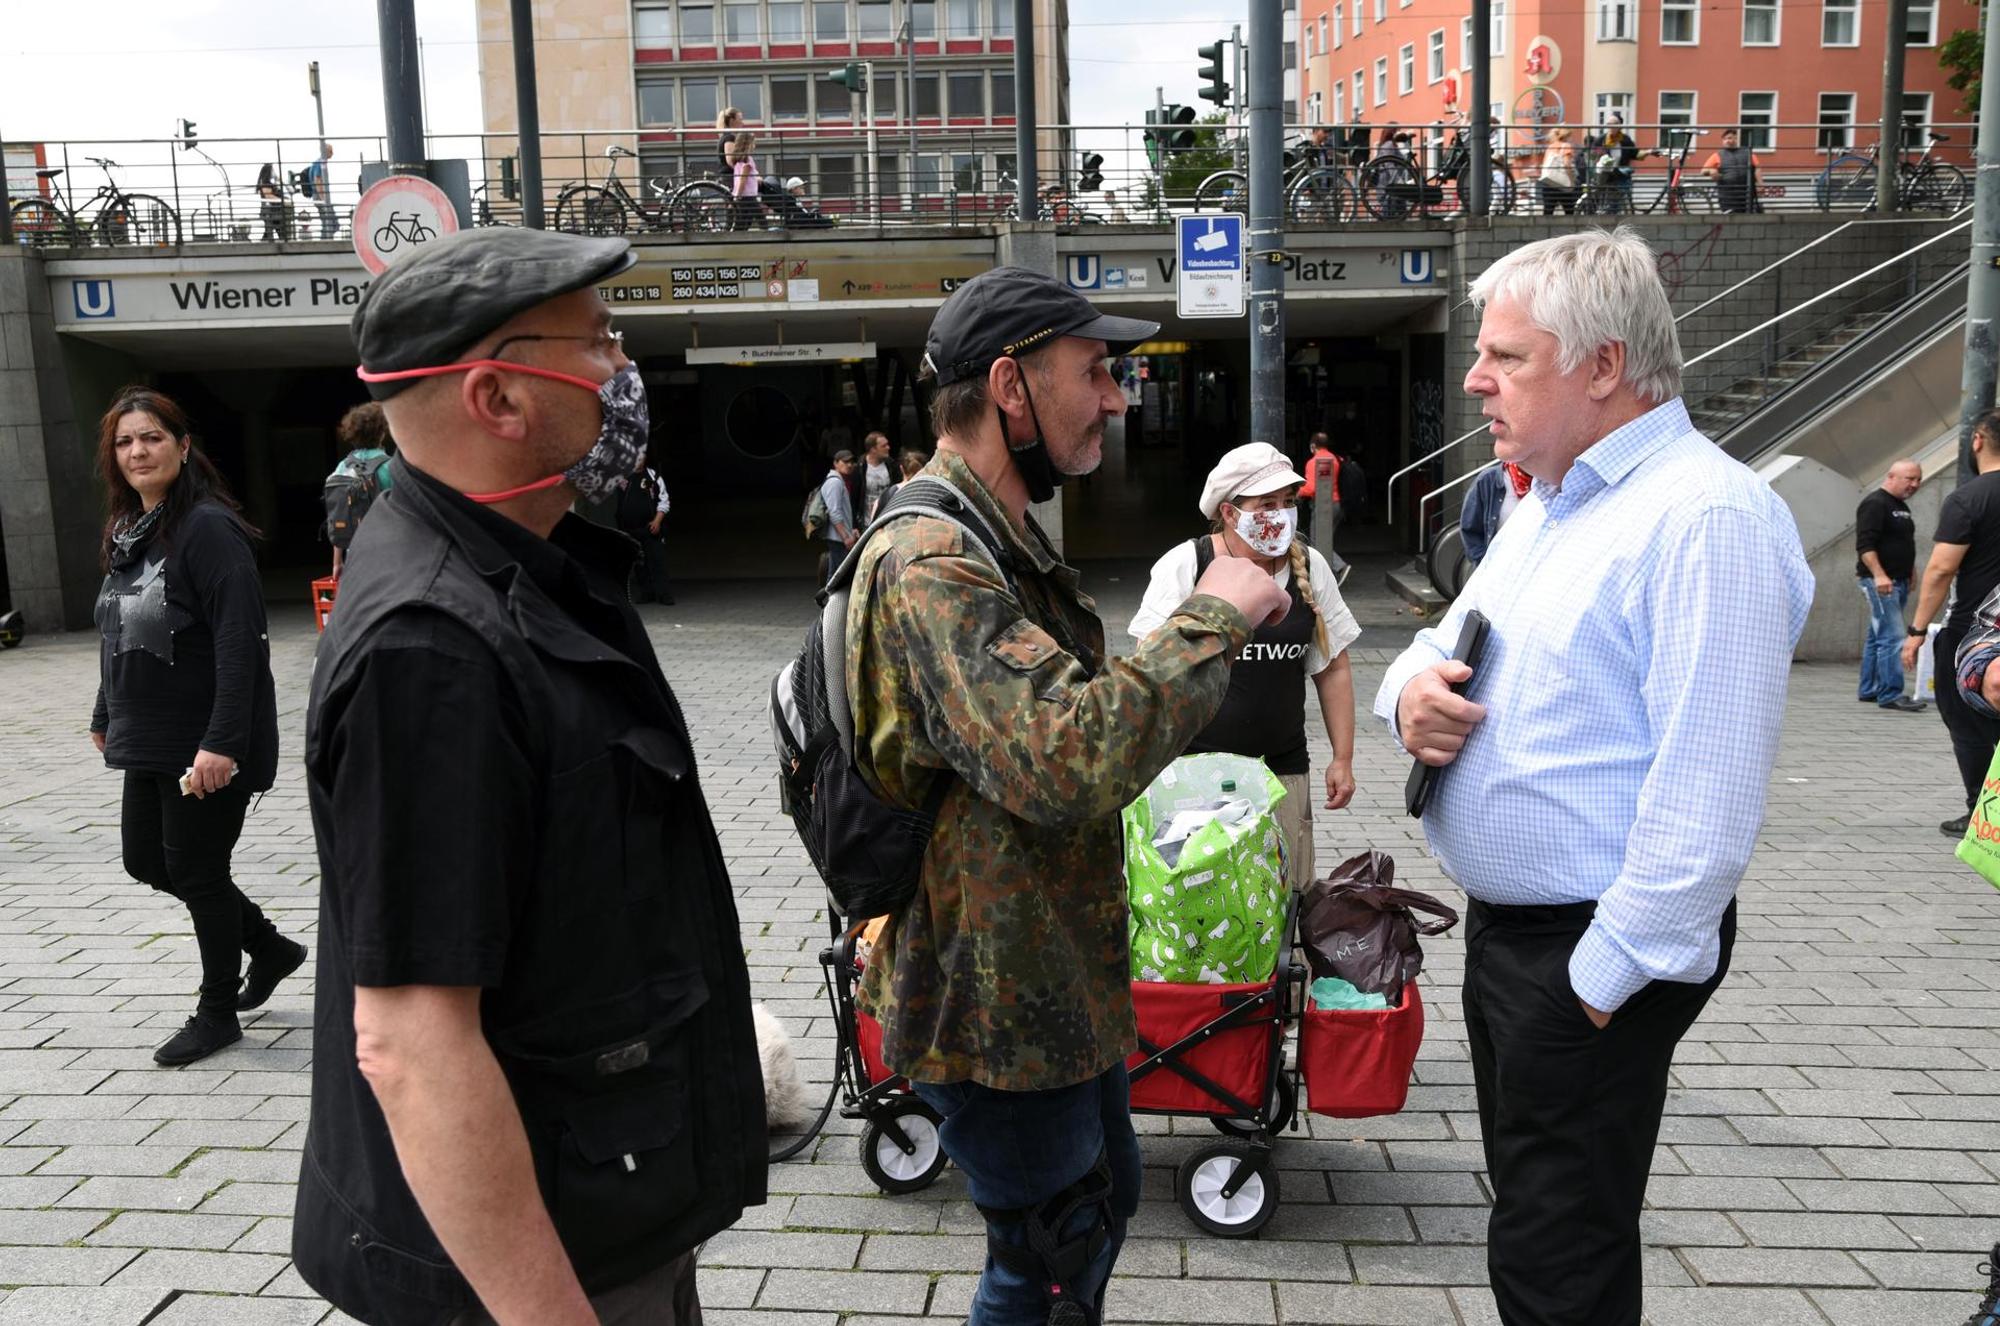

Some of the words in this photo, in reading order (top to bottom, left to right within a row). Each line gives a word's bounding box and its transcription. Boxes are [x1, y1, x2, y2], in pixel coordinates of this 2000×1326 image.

[1272, 253, 1281, 262] 23
[1069, 256, 1098, 288] U
[1402, 251, 1430, 281] U
[672, 270, 692, 281] 150
[695, 269, 714, 280] 155
[718, 268, 737, 279] 156
[740, 267, 761, 278] 250
[170, 281, 296, 310] Wiener
[616, 287, 625, 298] 4
[630, 286, 644, 298] 13
[647, 287, 660, 298] 18
[673, 287, 693, 298] 260
[695, 286, 716, 297] 434
[718, 285, 739, 296] N26
[77, 282, 112, 317] U
[752, 350, 796, 358] Buchheimer
[798, 349, 809, 357] Str.
